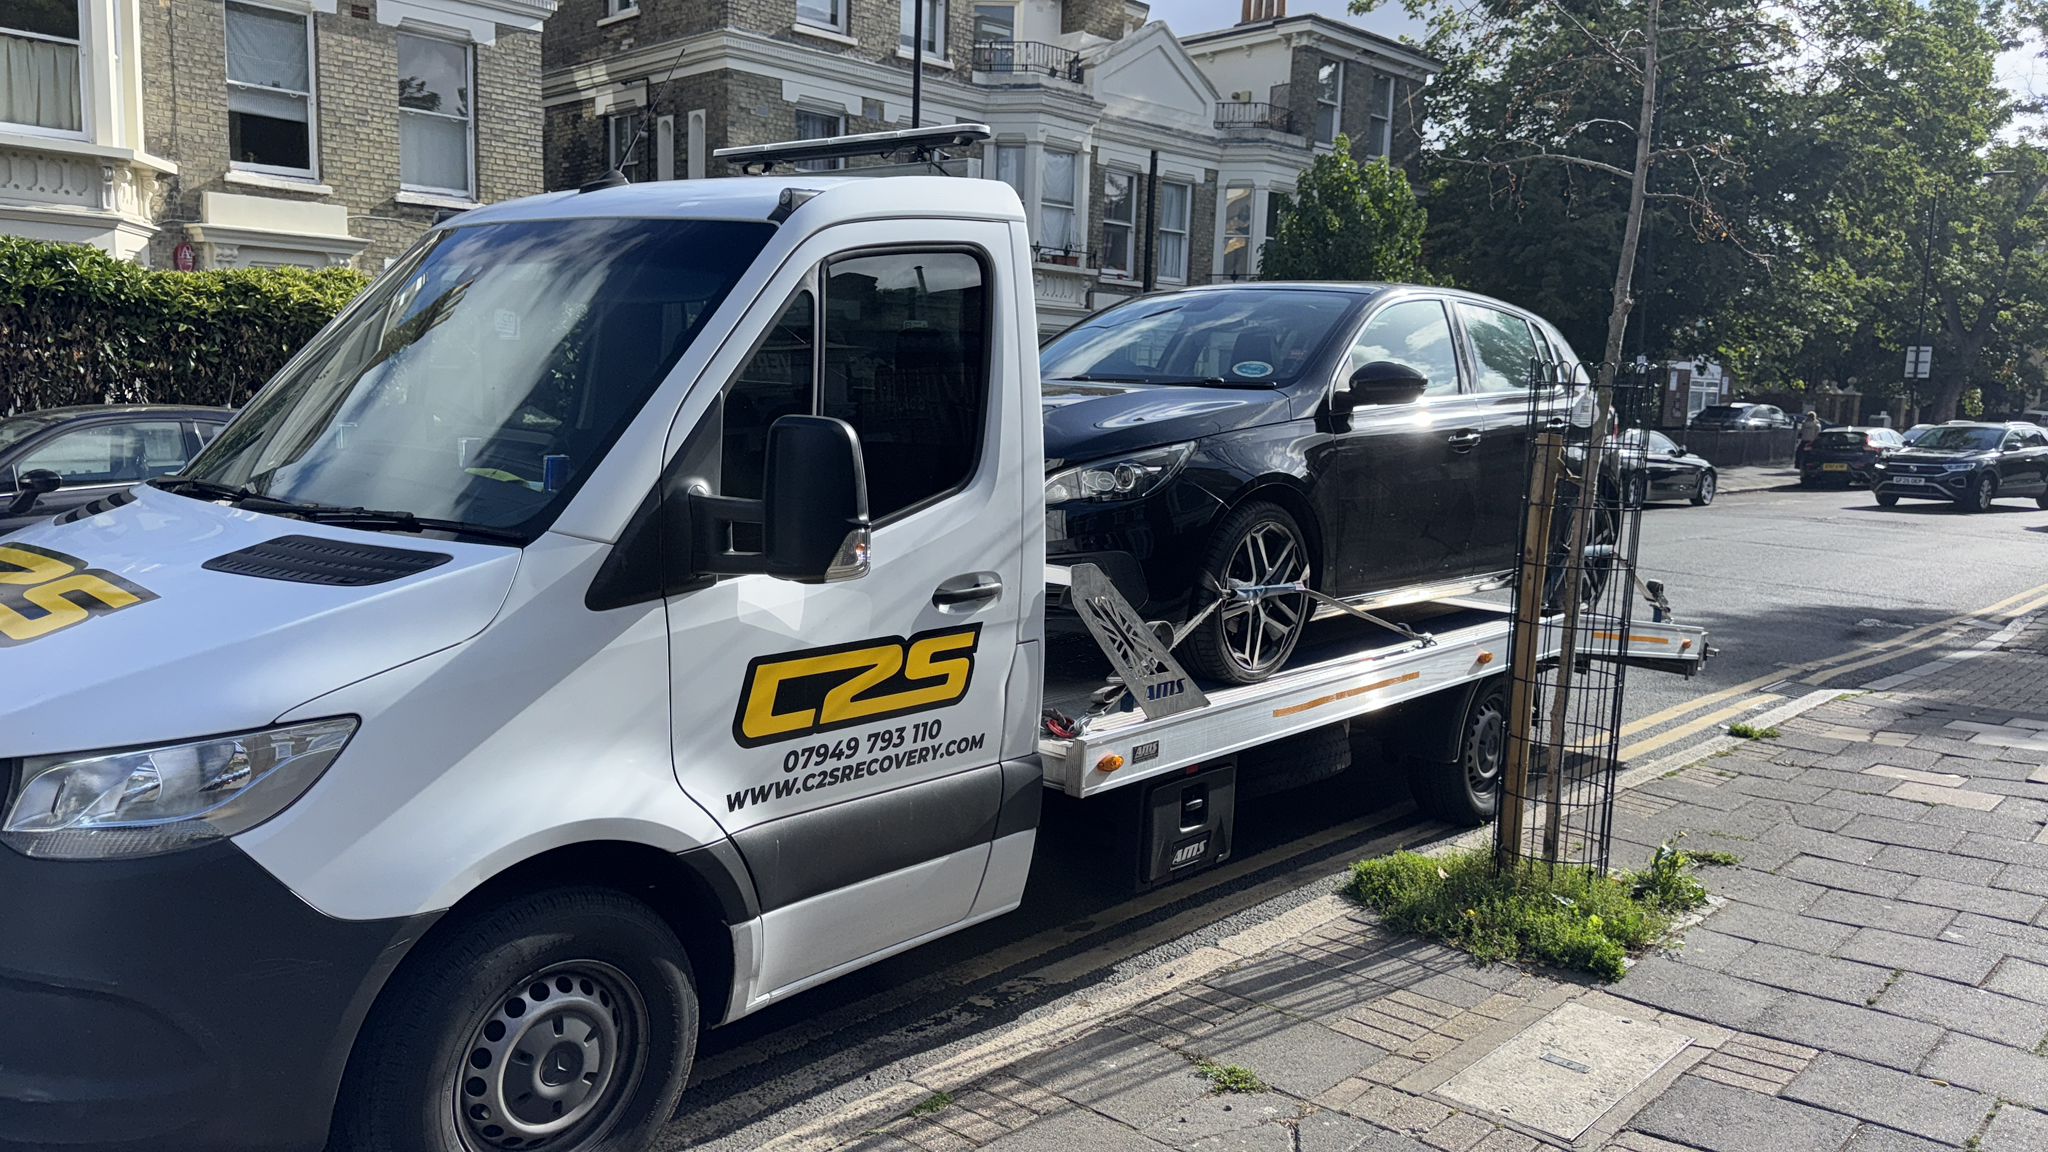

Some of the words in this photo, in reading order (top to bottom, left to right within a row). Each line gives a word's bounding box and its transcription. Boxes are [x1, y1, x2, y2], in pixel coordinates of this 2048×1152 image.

[0, 546, 142, 641] 2S
[742, 631, 976, 738] C2S
[1146, 678, 1185, 701] AMS
[726, 733, 985, 812] WWW.C2SRECOVERY.COM
[783, 737, 860, 773] 07949
[867, 726, 906, 754] 793
[912, 719, 942, 742] 110
[1172, 840, 1207, 865] AMS
